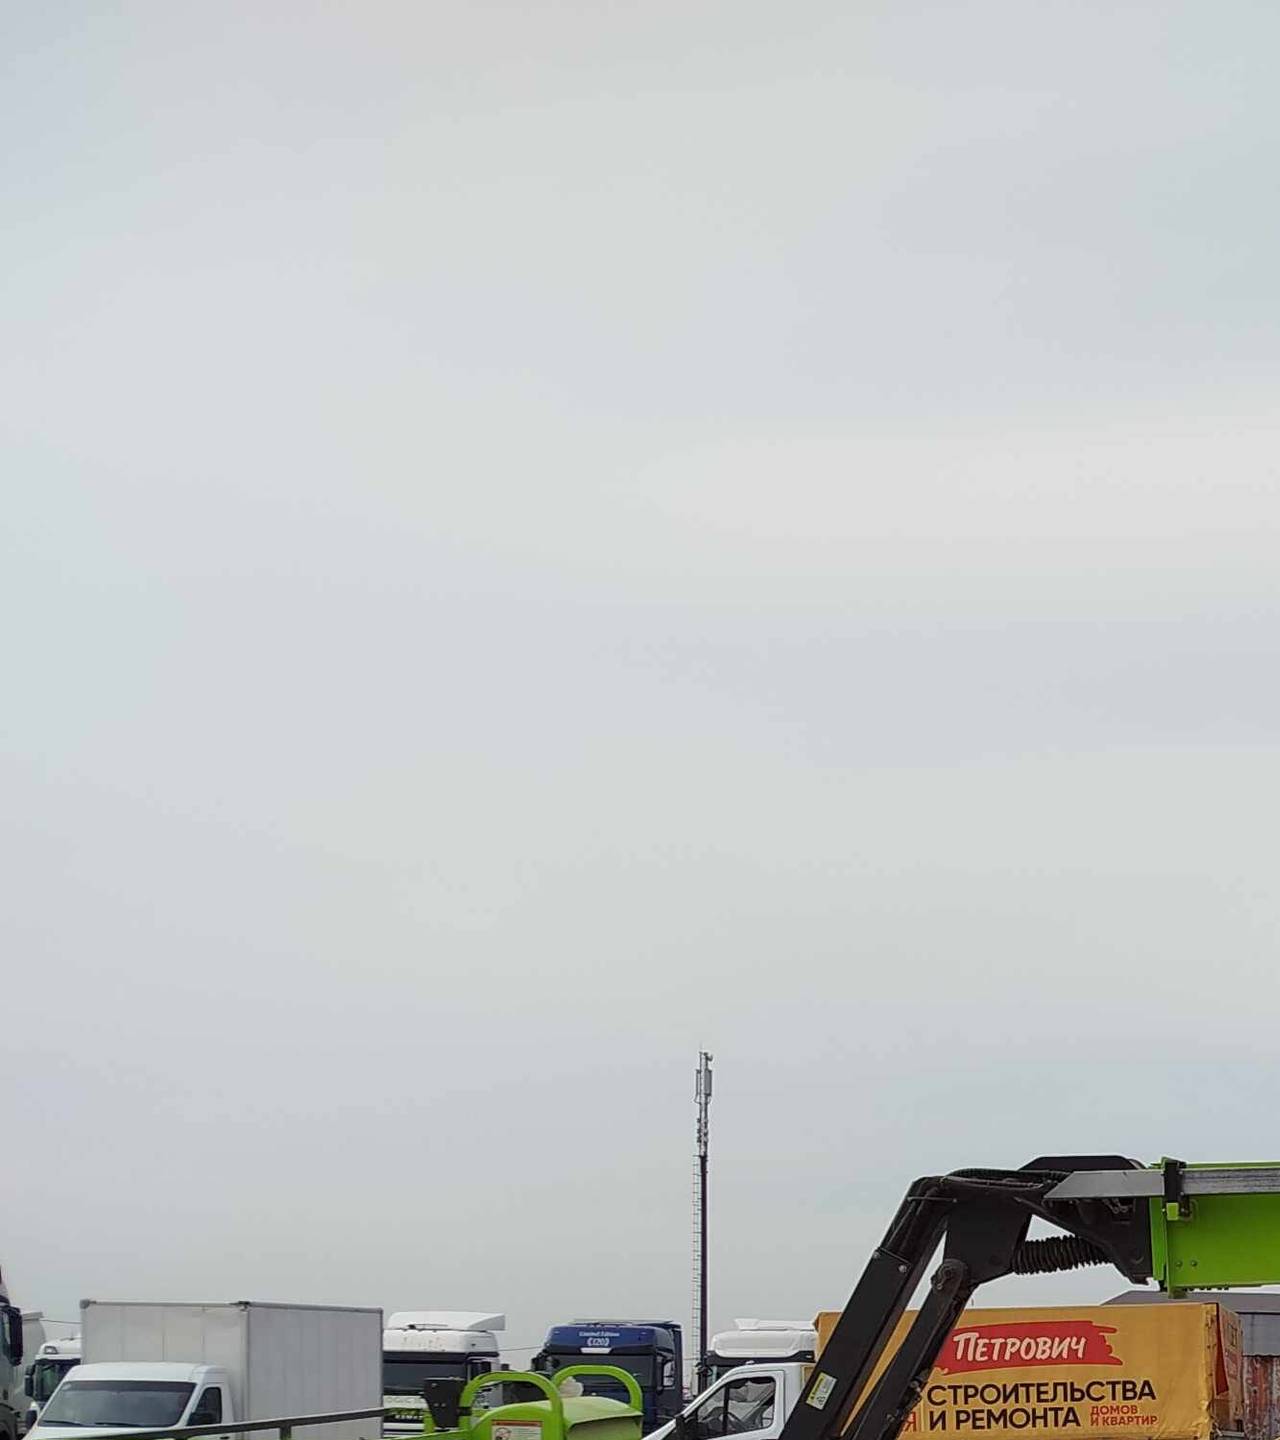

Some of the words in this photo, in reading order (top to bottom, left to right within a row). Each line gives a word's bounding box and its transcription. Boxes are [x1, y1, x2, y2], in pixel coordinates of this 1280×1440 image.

[952, 1331, 1087, 1362] ПЕТРОВИЧ
[926, 1380, 1157, 1406] СТРОИТЕЛЬСТВА
[929, 1410, 947, 1431] И
[955, 1406, 1081, 1430] РЕМОНТА
[1090, 1404, 1138, 1417] ДОМОВ
[1090, 1416, 1100, 1427] И
[1102, 1415, 1158, 1427] КВАРТИР
